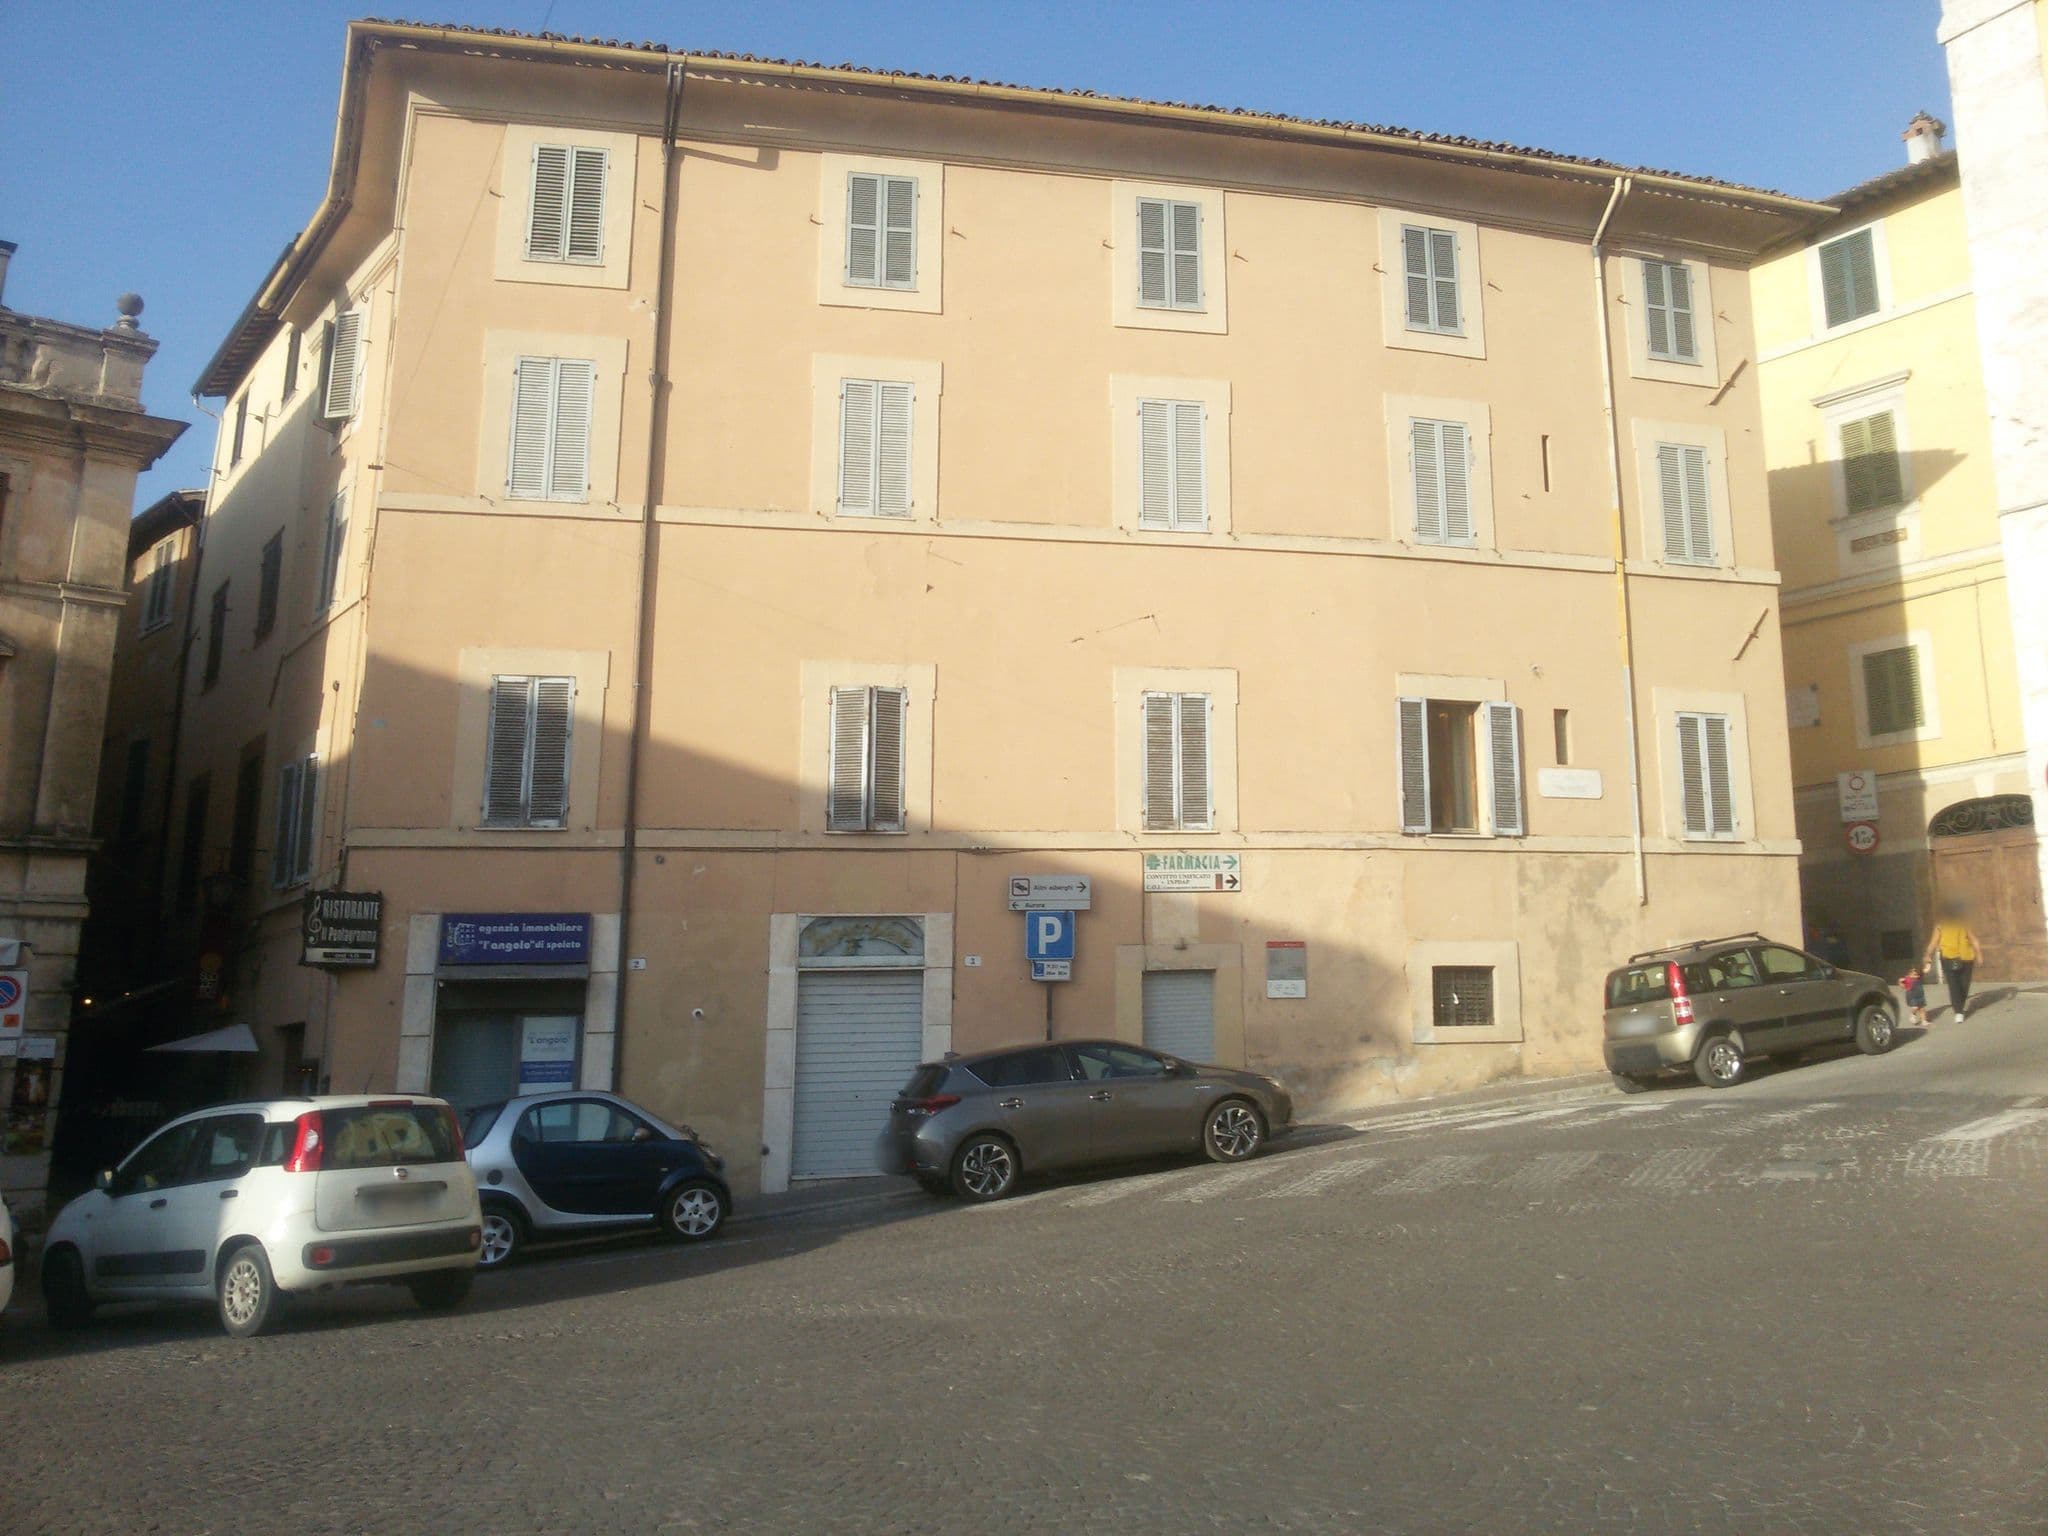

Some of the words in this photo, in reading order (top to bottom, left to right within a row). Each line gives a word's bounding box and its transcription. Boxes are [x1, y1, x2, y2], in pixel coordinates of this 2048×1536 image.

[1163, 855, 1220, 870] FARMACIA
[1049, 884, 1073, 892] alberghi
[322, 899, 379, 920] RISTORANTE
[328, 927, 377, 944] Pentagramma
[479, 923, 520, 934] agenzia
[522, 922, 584, 932] immobiliare
[1039, 916, 1062, 955] P
[535, 940, 545, 949] di
[546, 940, 581, 951] spoleto
